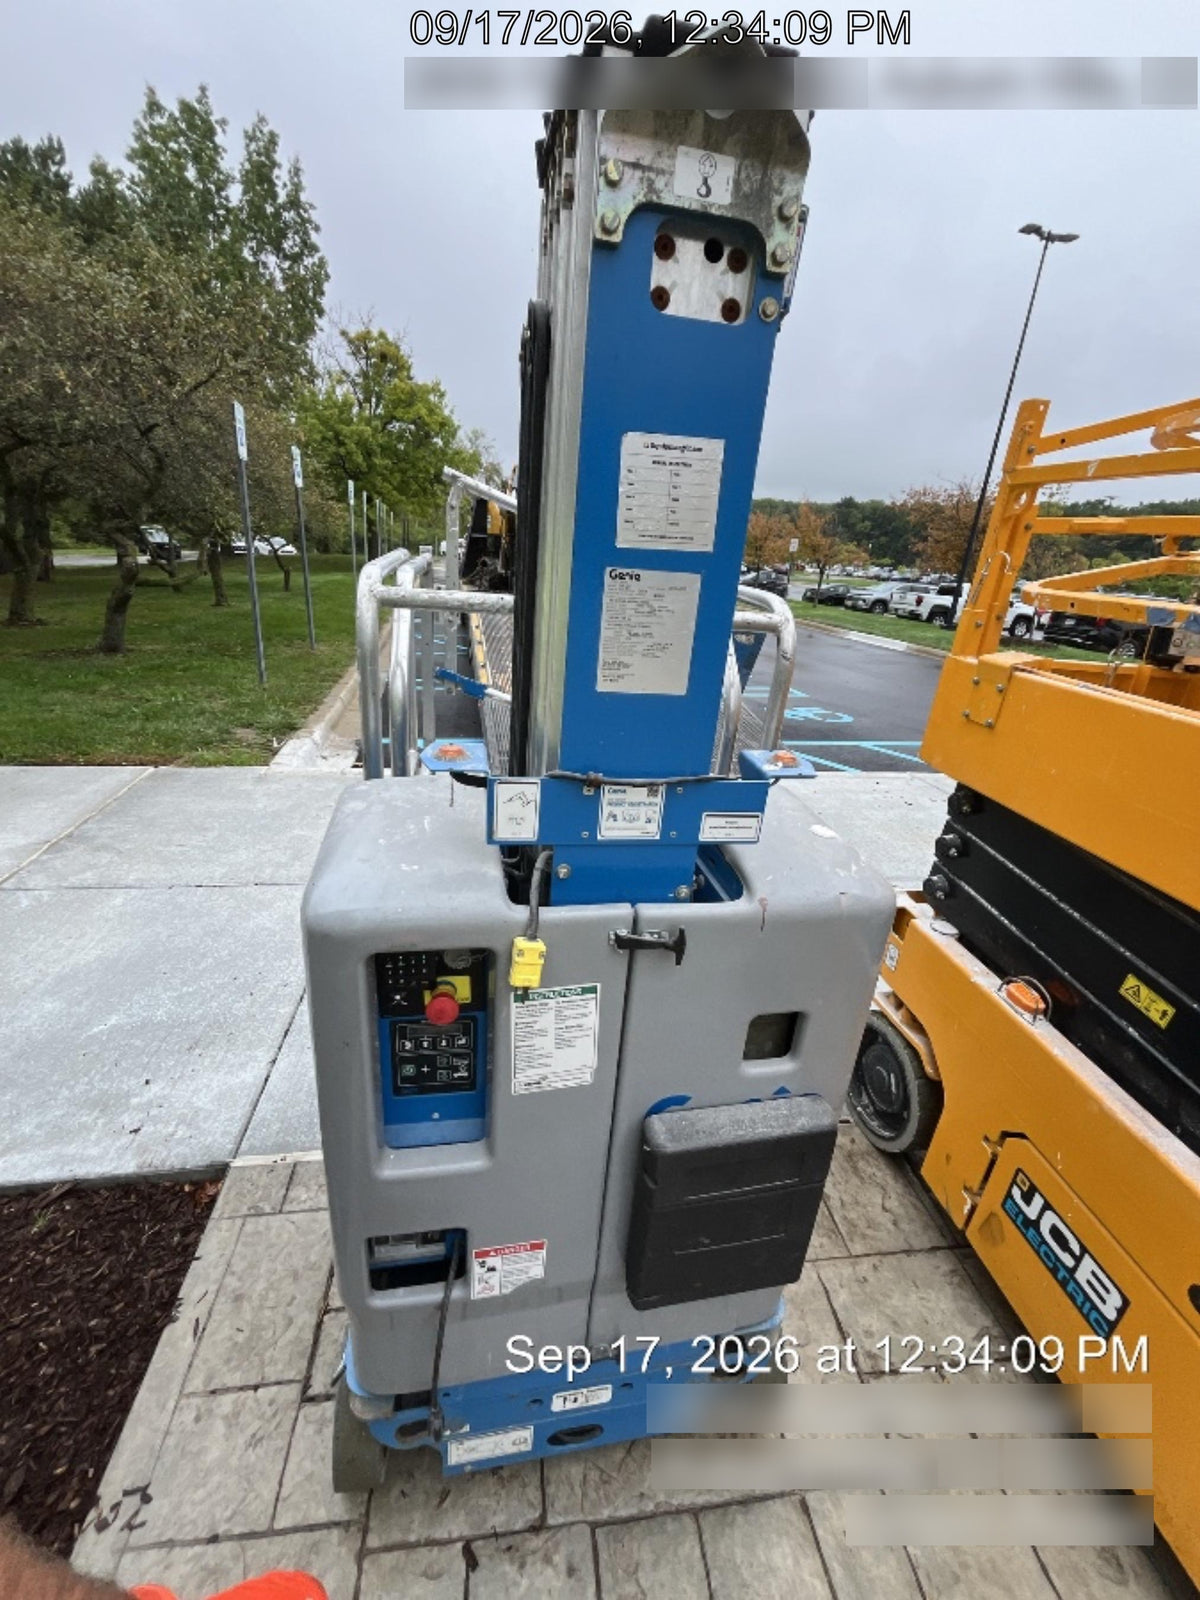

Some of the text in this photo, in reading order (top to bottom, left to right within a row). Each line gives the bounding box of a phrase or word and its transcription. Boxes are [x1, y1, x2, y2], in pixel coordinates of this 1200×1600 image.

[609, 568, 641, 581] Genie
[1003, 1198, 1110, 1338] ELECTRIC
[1011, 1184, 1123, 1322] JCB
